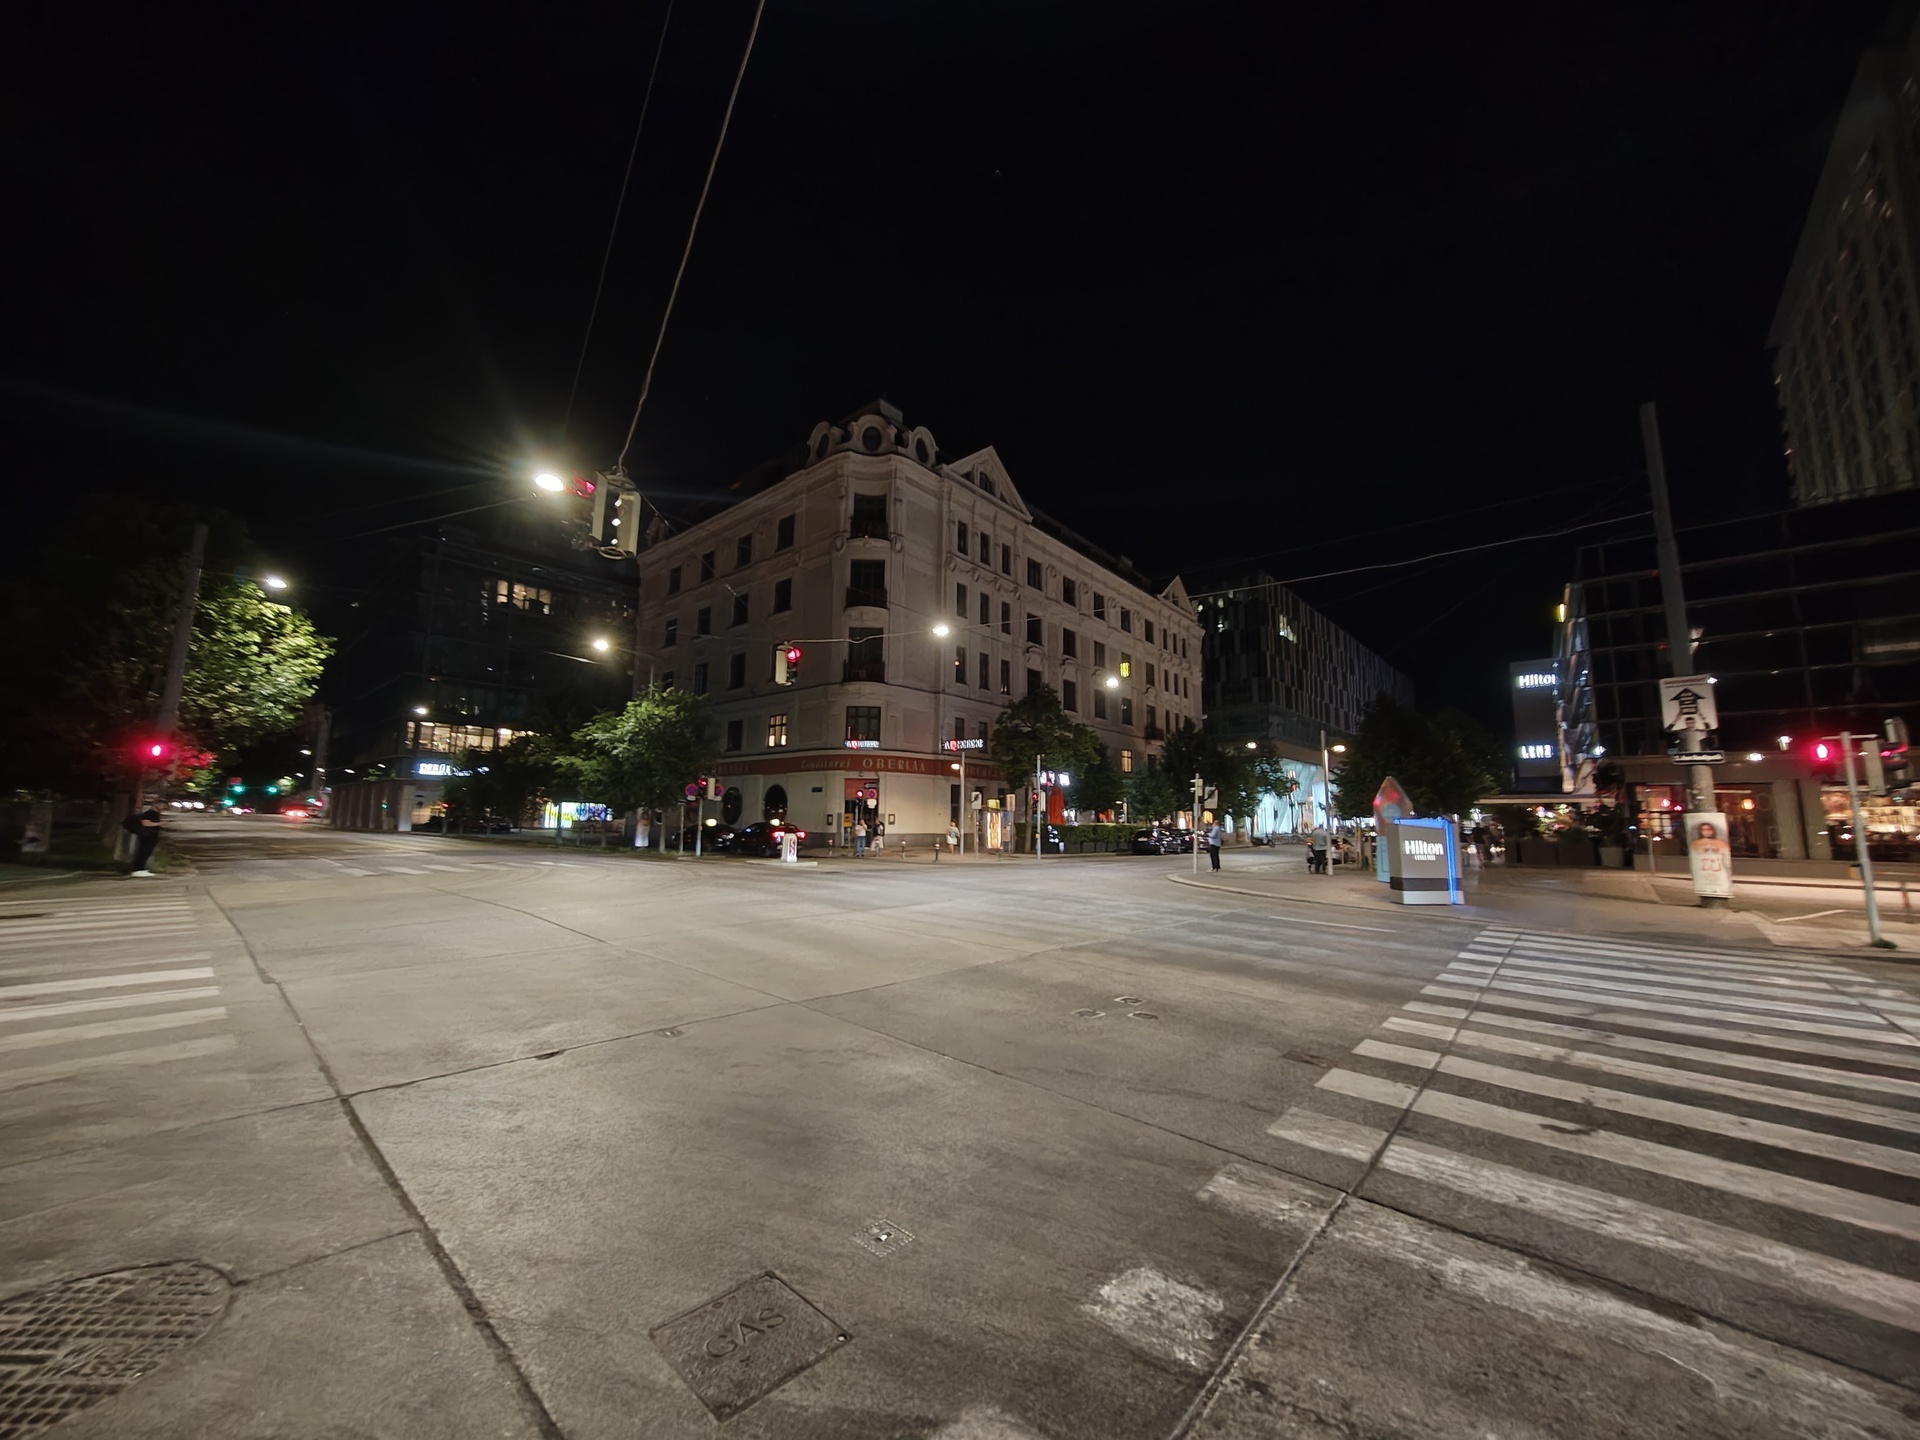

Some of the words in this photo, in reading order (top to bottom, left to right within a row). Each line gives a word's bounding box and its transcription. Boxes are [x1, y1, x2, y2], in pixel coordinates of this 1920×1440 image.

[862, 757, 926, 773] OBERLAA
[1404, 840, 1444, 856] Hilton
[704, 1307, 786, 1359] GAS
